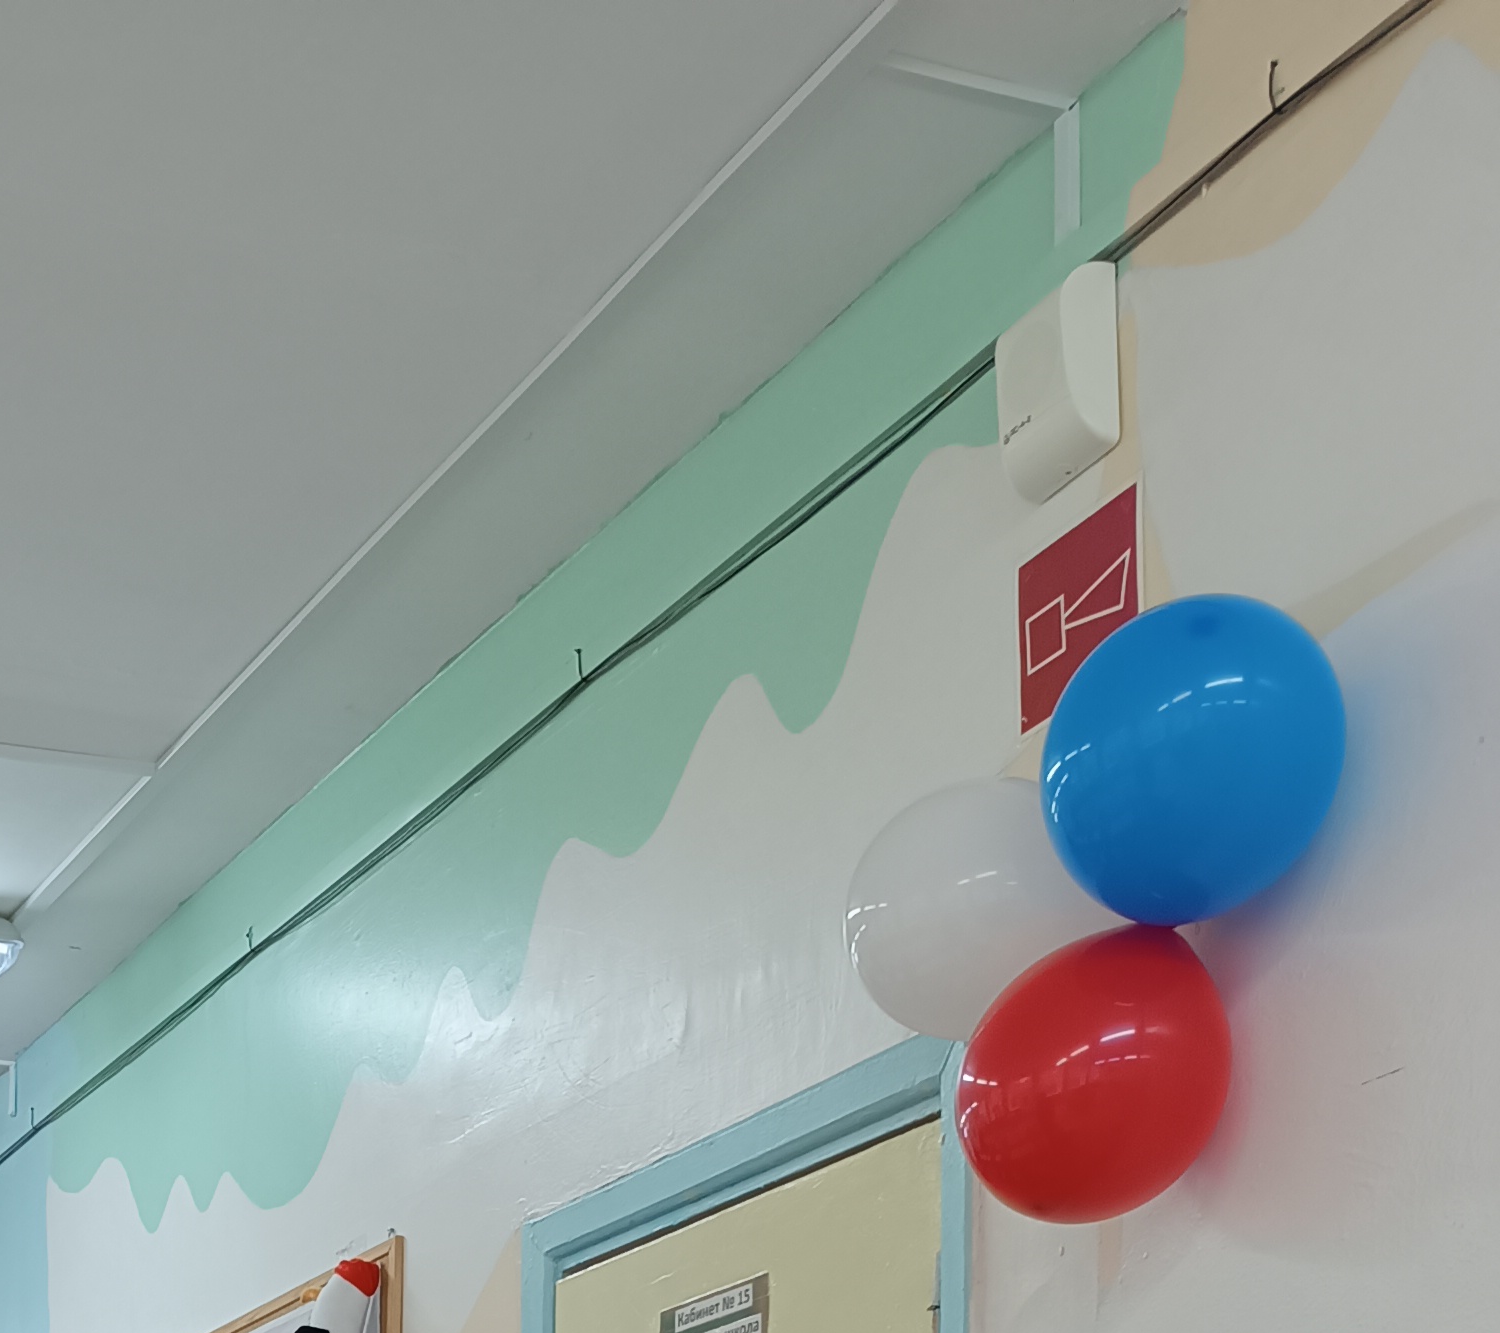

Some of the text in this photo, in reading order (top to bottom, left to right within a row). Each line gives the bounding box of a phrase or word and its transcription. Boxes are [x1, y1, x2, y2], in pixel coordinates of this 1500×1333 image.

[677, 1289, 750, 1328] Кабинет № 15
